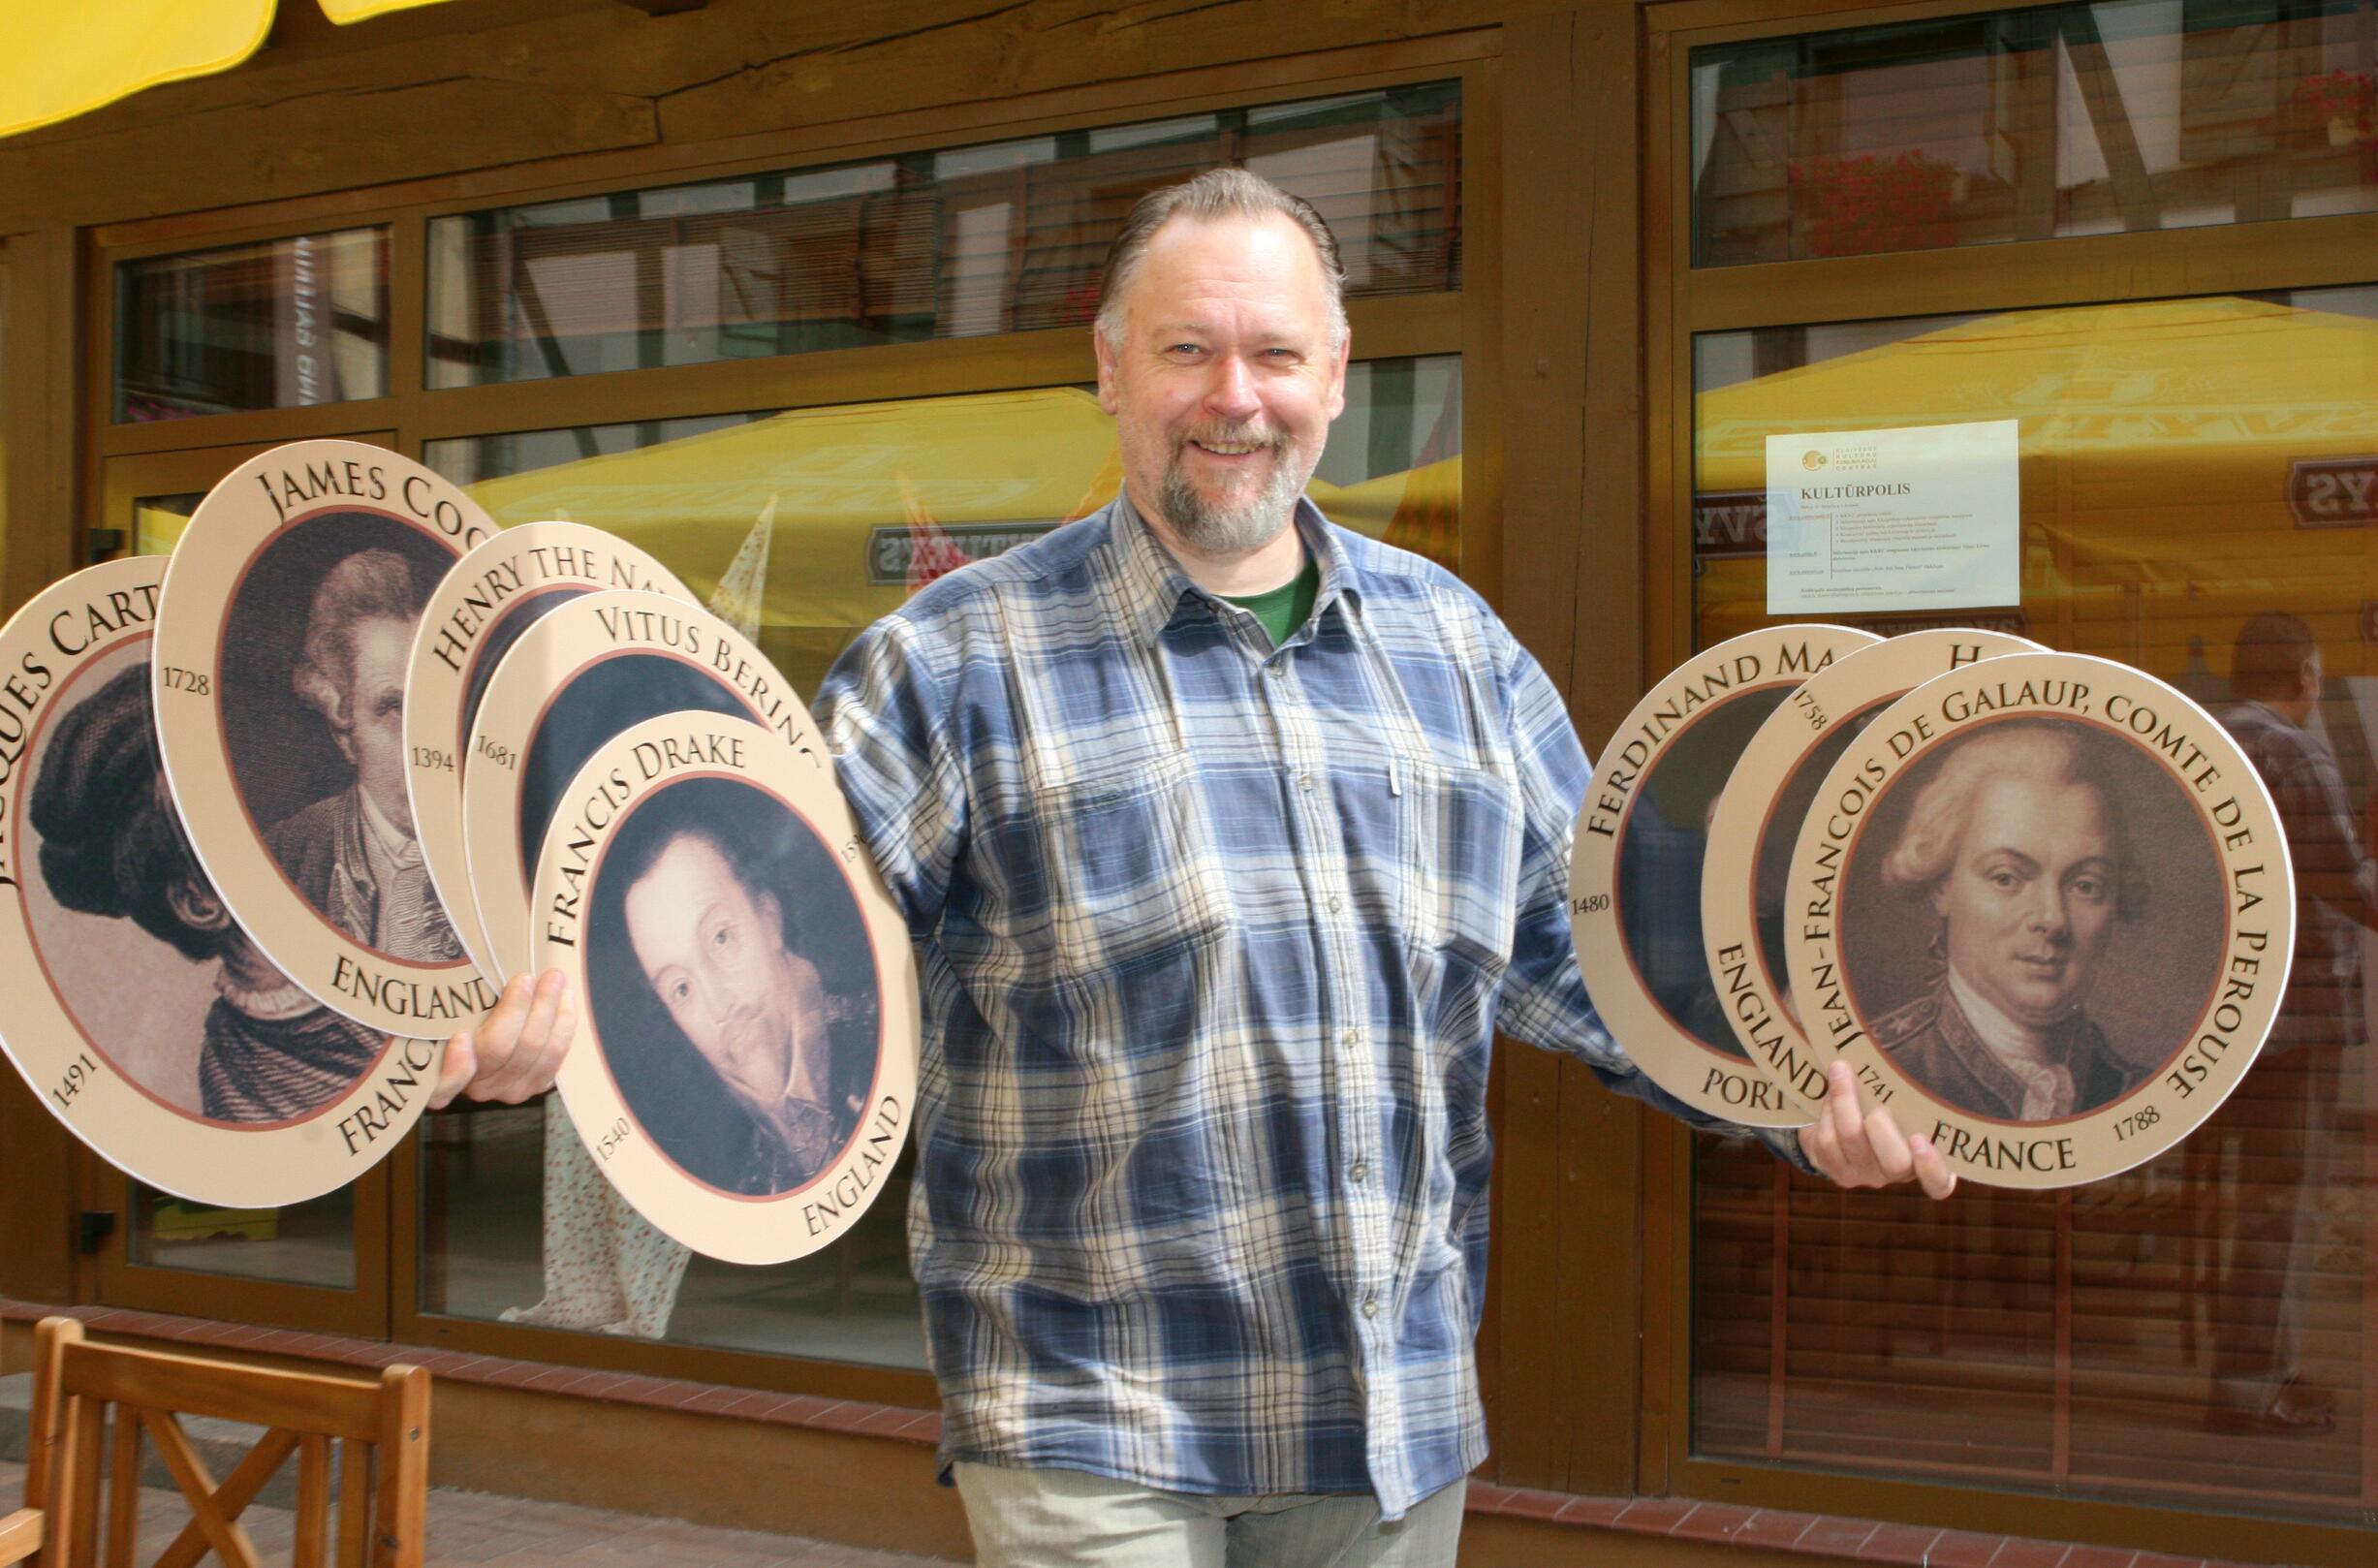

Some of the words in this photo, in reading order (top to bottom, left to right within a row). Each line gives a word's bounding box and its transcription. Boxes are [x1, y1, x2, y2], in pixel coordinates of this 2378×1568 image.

[256, 460, 386, 527] JAMES
[1800, 484, 1911, 500] KULTŪRPOLIS
[49, 584, 159, 656] CART
[432, 555, 527, 673] HENRY
[528, 547, 597, 580] THE
[593, 607, 702, 654] VITUS
[163, 667, 209, 696] 1728
[1941, 680, 2089, 723] GALAUP,
[1793, 689, 1830, 731] 1758
[412, 746, 455, 772] 1394
[476, 735, 516, 771] 1681
[1587, 655, 1762, 838] FERDINAND
[1887, 714, 1935, 761] DE
[2105, 695, 2222, 793] COMTE
[548, 768, 631, 948] FRANCIS
[632, 734, 745, 782] DRAKE
[2210, 797, 2253, 851] DE
[1572, 894, 1610, 915] 1480
[2234, 862, 2266, 915] LA
[330, 954, 499, 1019] ENGLAND
[1718, 943, 1830, 1101] ENGLAND
[2166, 929, 2268, 1100] PEROUSE
[51, 1052, 98, 1110] 1491
[336, 1038, 437, 1156] FRANC
[1858, 1063, 1894, 1104] 1741
[595, 1116, 632, 1163] 1540
[1929, 1119, 2077, 1172] FRANCE
[2112, 1105, 2161, 1143] 1788
[800, 1095, 902, 1238] ENGLAND
